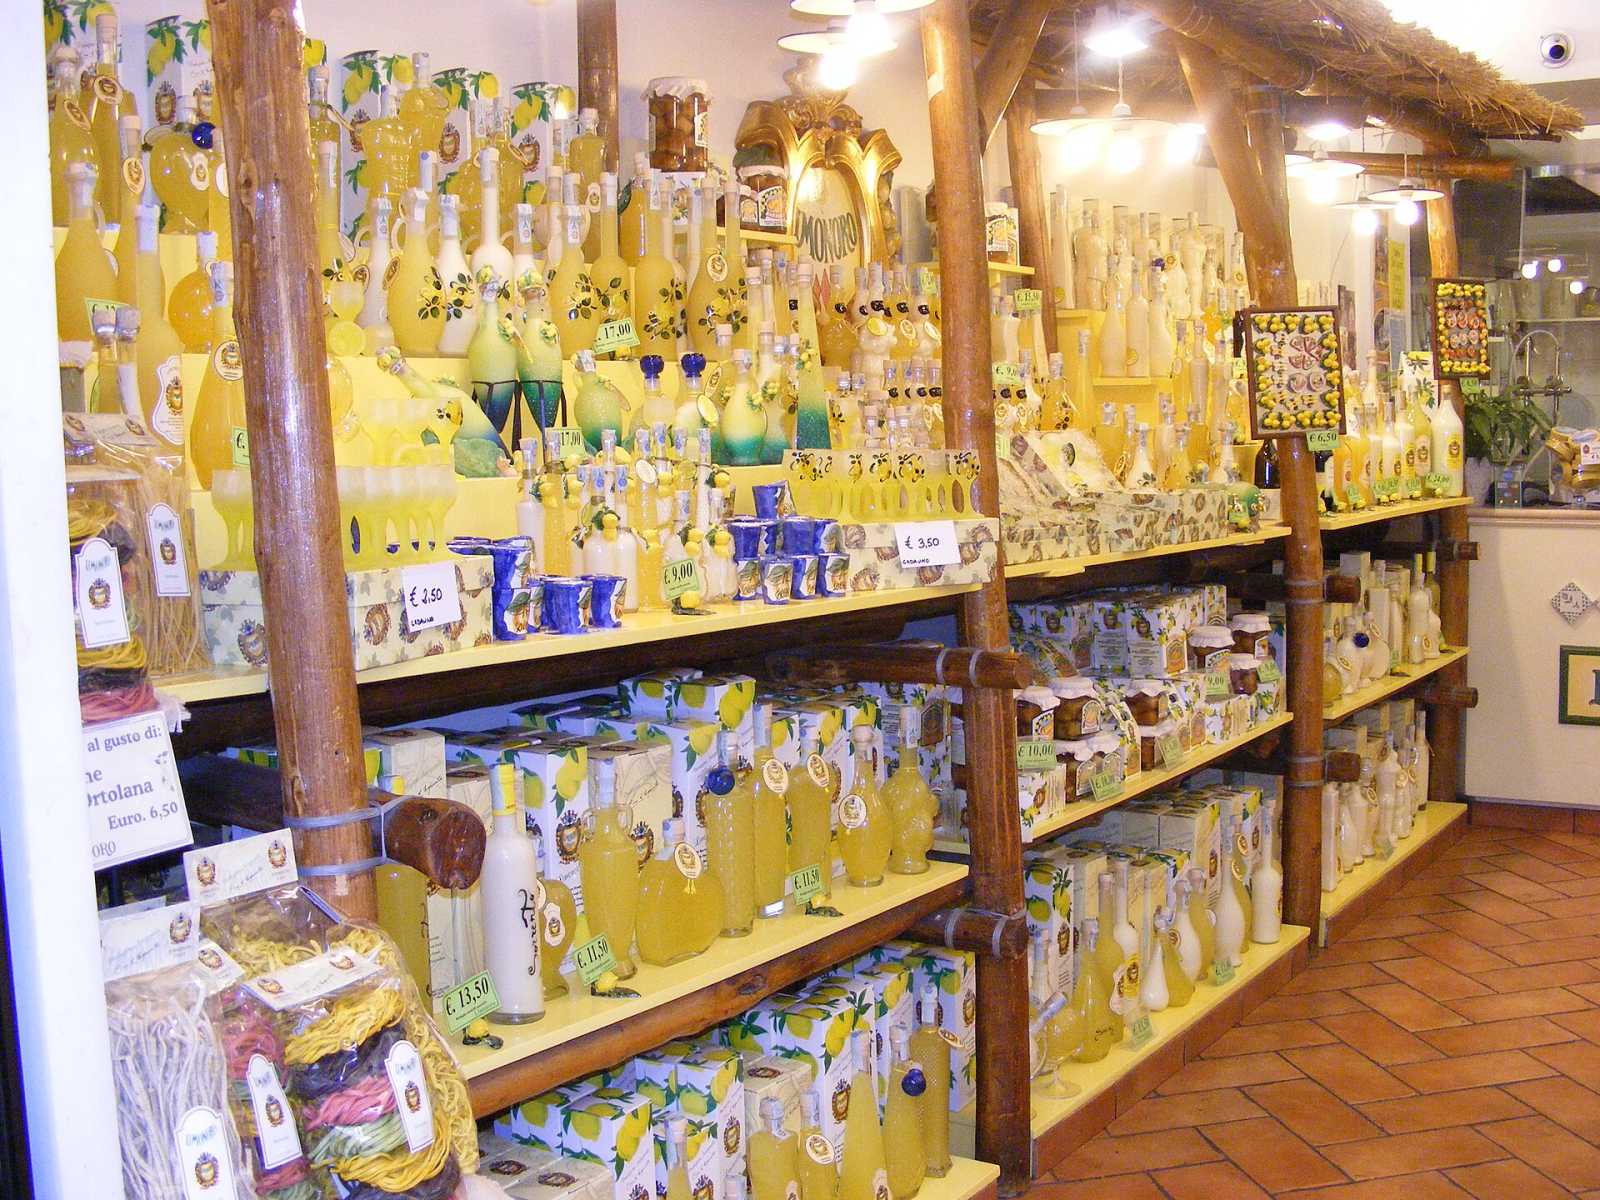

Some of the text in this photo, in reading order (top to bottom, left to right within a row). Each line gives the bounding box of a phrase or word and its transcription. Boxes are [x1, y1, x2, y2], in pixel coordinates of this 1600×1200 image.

[1317, 432, 1337, 442] 6,50
[904, 535, 940, 549] € 3,50
[672, 561, 693, 581] 9,00
[409, 585, 443, 607] € 2,50
[87, 725, 162, 752] al gusto di:
[1029, 742, 1053, 757] 10,00
[107, 801, 178, 831] Euro. 6,50
[587, 938, 608, 962] 11,50
[459, 976, 489, 1008] 13,50
